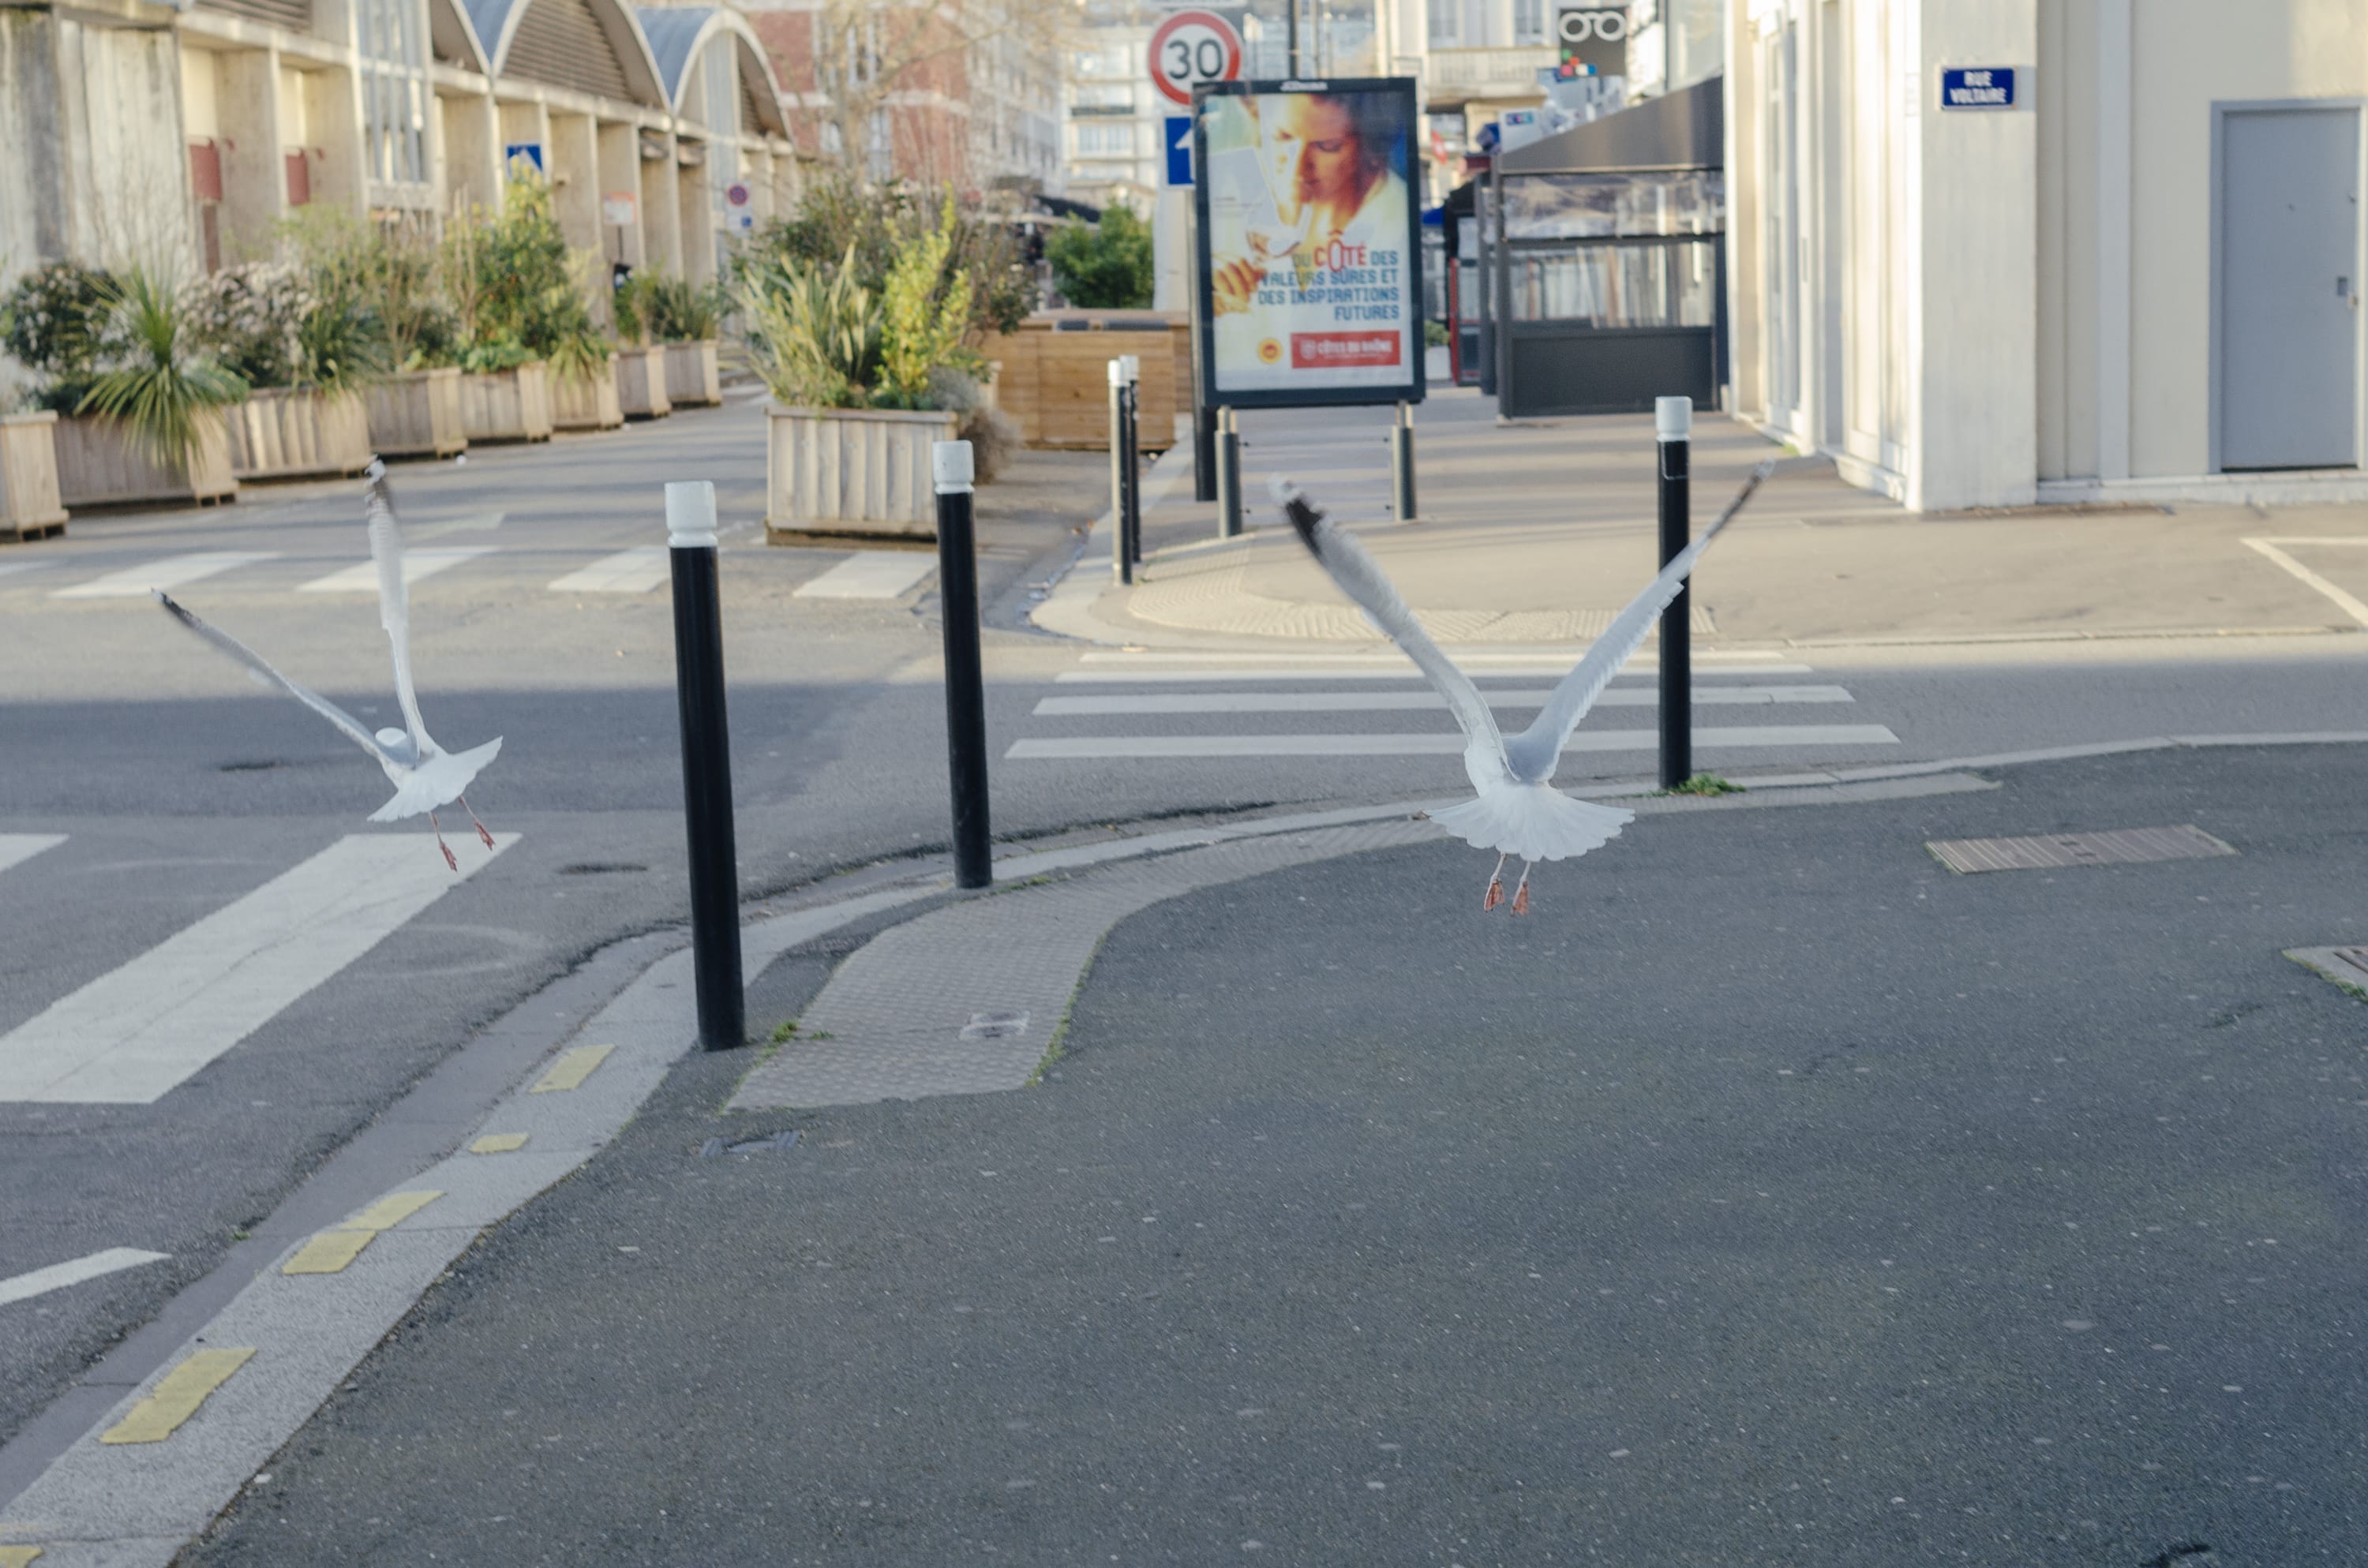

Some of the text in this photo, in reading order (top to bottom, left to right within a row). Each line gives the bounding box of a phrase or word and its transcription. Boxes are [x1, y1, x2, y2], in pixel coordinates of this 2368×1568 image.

[1167, 38, 1223, 80] 30
[1964, 70, 1993, 87] RUE
[1293, 253, 1311, 267] DU
[1370, 250, 1399, 265] DES
[1261, 270, 1325, 286] VALEURS
[1381, 268, 1399, 283] ET
[1258, 286, 1399, 305] DES INSPIRATIONS
[1335, 305, 1399, 320] FUTURES
